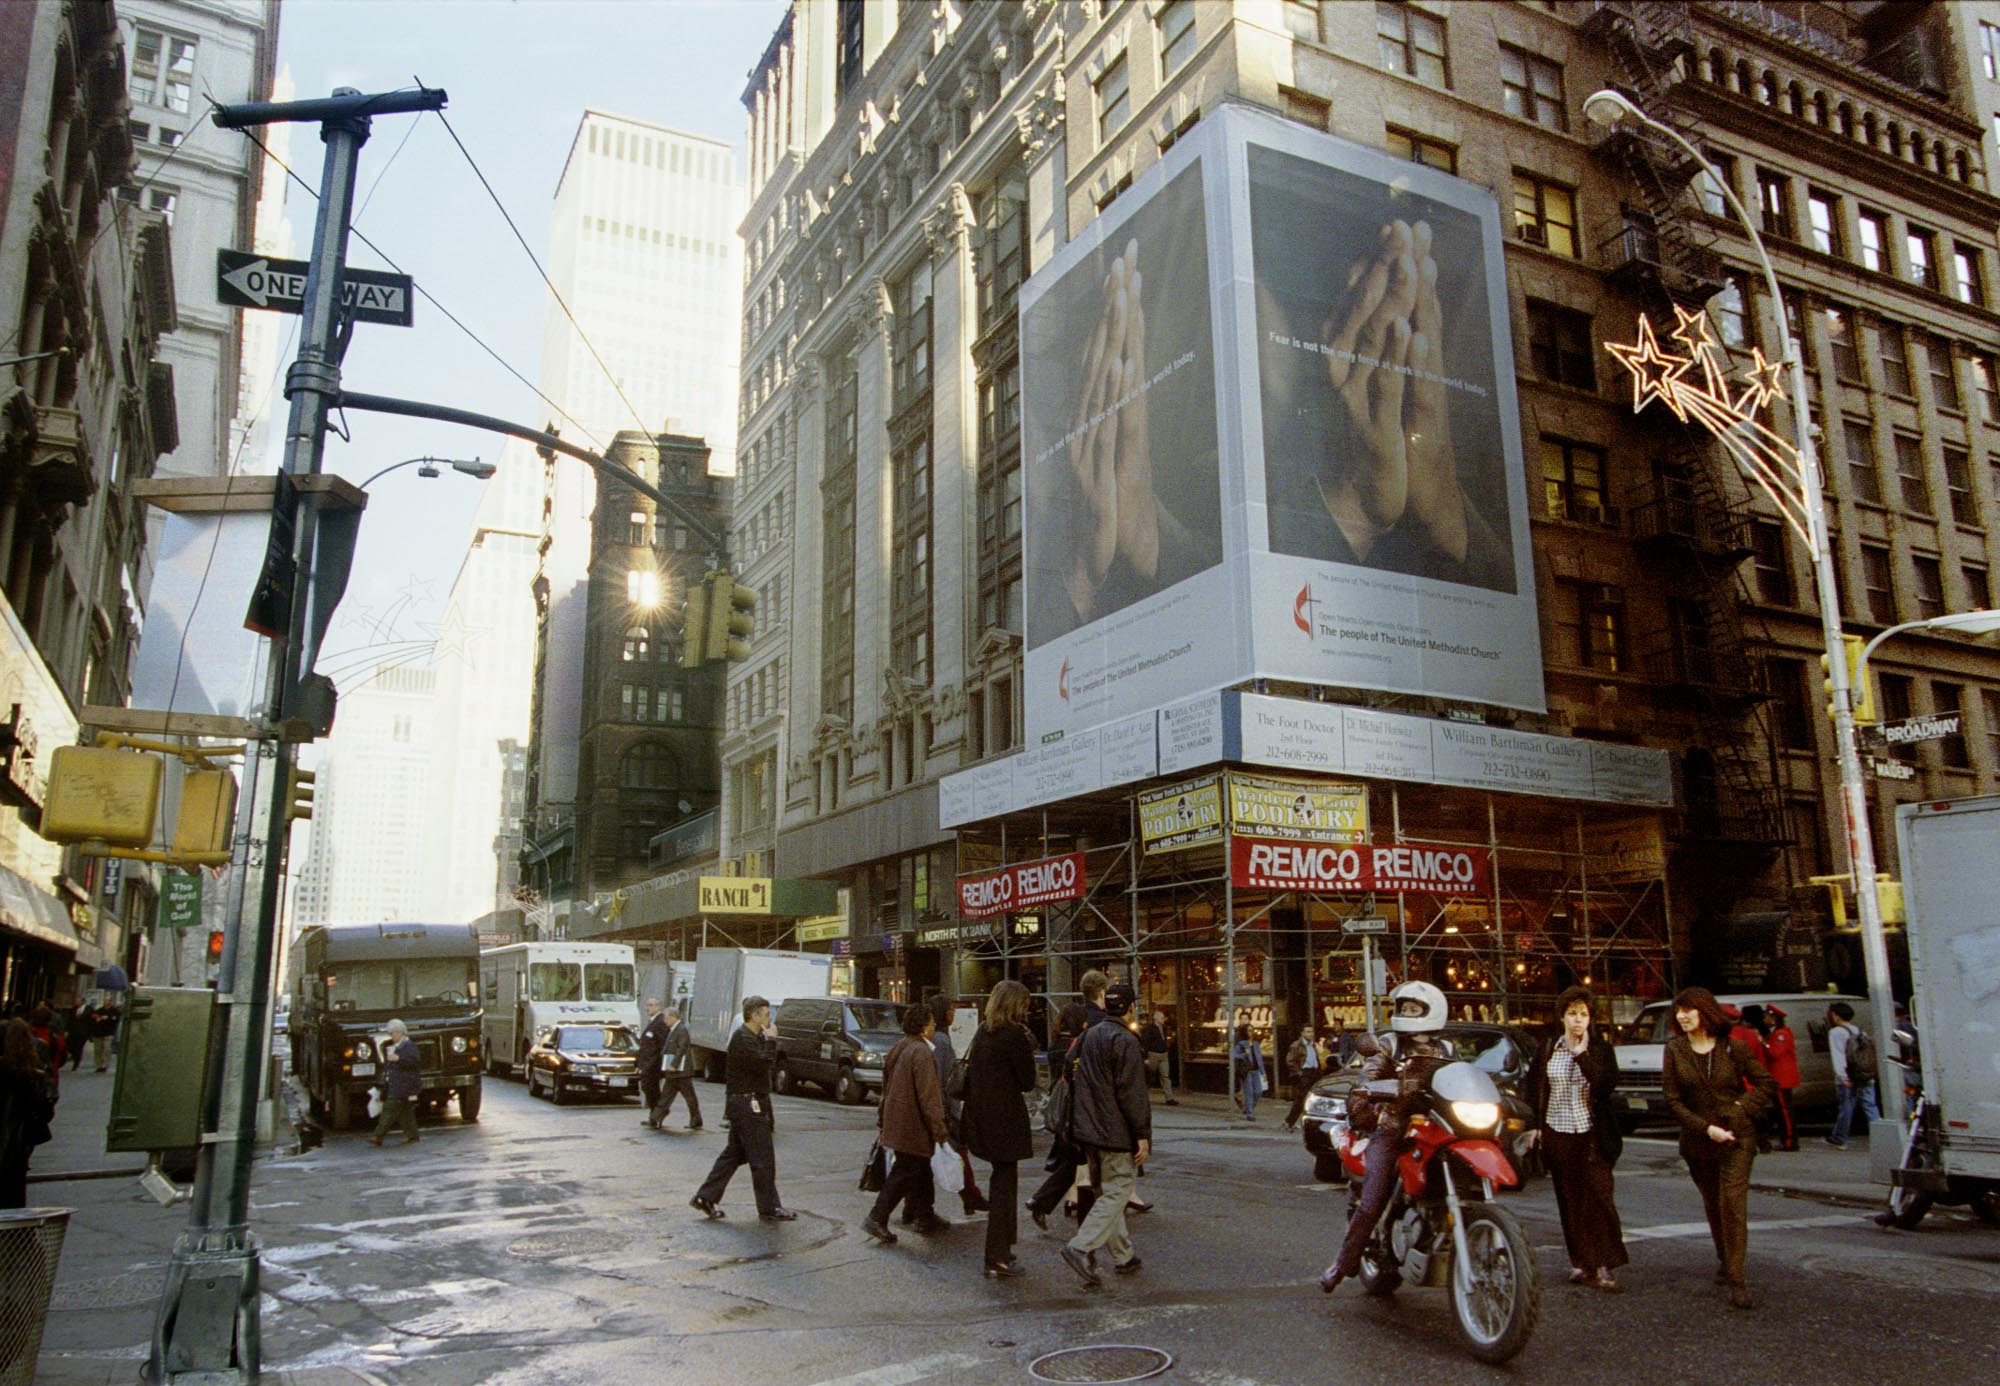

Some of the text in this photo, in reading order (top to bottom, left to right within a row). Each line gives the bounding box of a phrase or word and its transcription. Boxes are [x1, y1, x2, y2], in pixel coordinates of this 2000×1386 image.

[247, 271, 396, 308] ONE WAY
[1269, 331, 1289, 345] Fear
[1292, 336, 1301, 348] is
[1303, 341, 1318, 352] not
[1321, 343, 1335, 356] the
[1320, 624, 1500, 660] The people of The United Methodist Church
[1256, 712, 1337, 734] The Foot Doctor
[1886, 717, 1959, 742] BROADWAY
[1442, 727, 1583, 759] William Barthman Gallery
[1266, 746, 1329, 763] 212-608-7999
[1236, 788, 1359, 808] Maiden Lane
[1143, 803, 1218, 838] PODIATRY
[1237, 801, 1357, 827] PODIATRY
[1256, 825, 1301, 838] 608-7999
[1249, 844, 1473, 882] REMCO REMCO
[172, 883, 193, 892] The
[962, 874, 1012, 907] REMCO
[1017, 858, 1075, 896] REMCO
[170, 892, 197, 901] World
[175, 902, 187, 911] of
[702, 887, 749, 907] RANCH
[170, 911, 192, 921] Golf
[925, 923, 992, 942] NORTH FOK BANK
